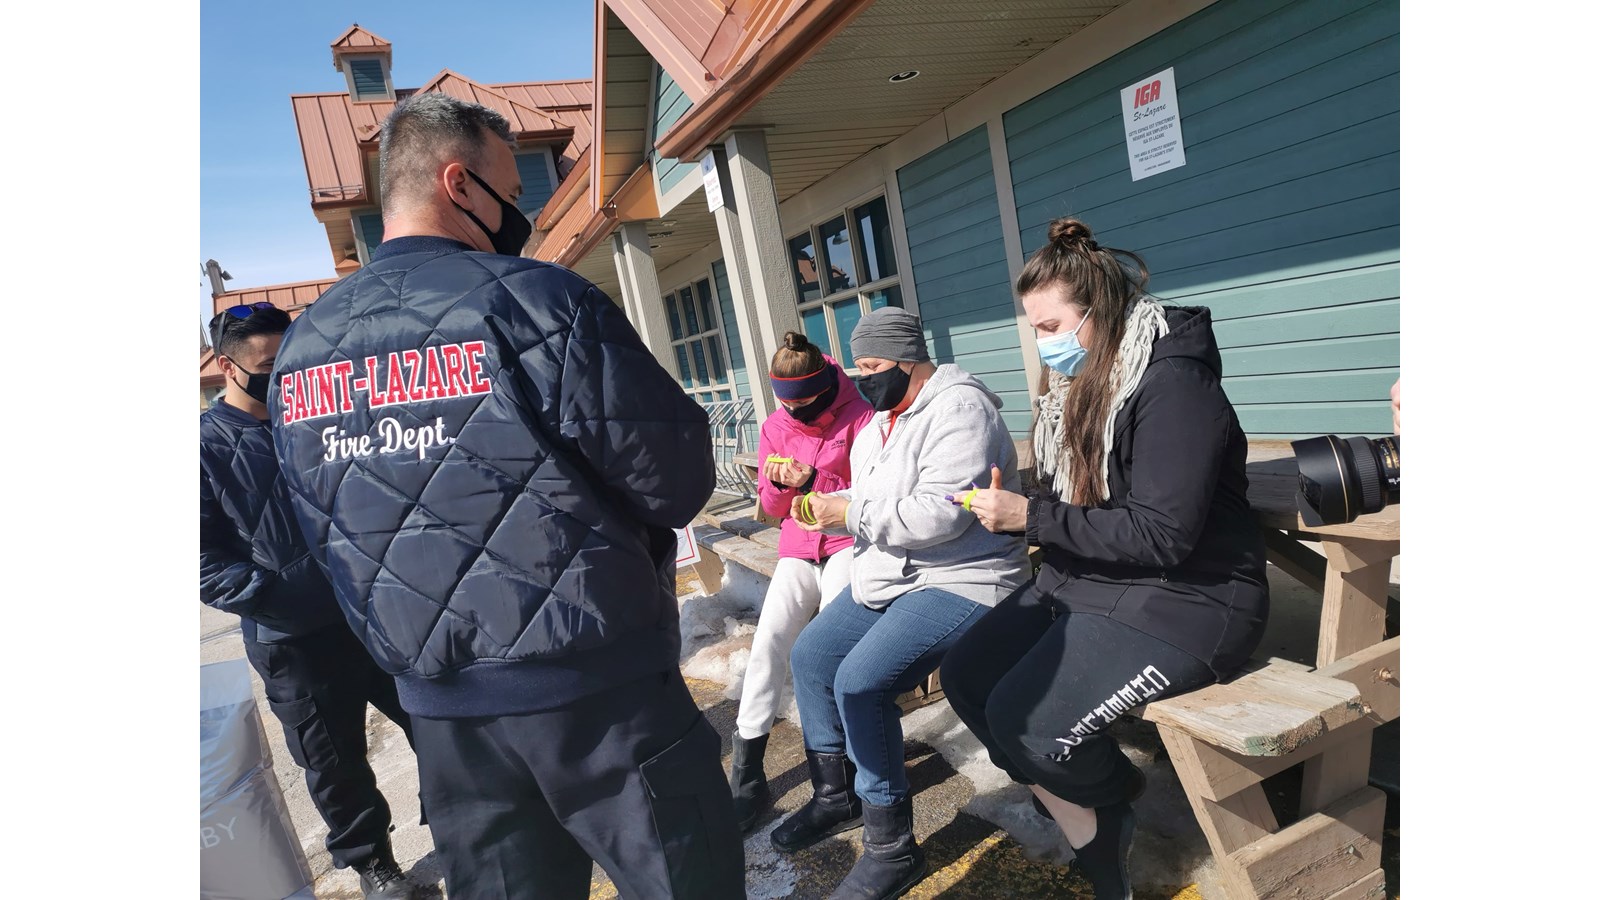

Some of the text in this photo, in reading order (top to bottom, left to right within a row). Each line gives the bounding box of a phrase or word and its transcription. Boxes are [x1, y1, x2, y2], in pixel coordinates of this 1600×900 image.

[1134, 80, 1161, 109] IGA
[1133, 104, 1167, 122] St-Lazare
[281, 341, 492, 425] SAINT-LAZARE
[322, 416, 456, 462] Fire Dept.
[200, 816, 238, 850] BY
